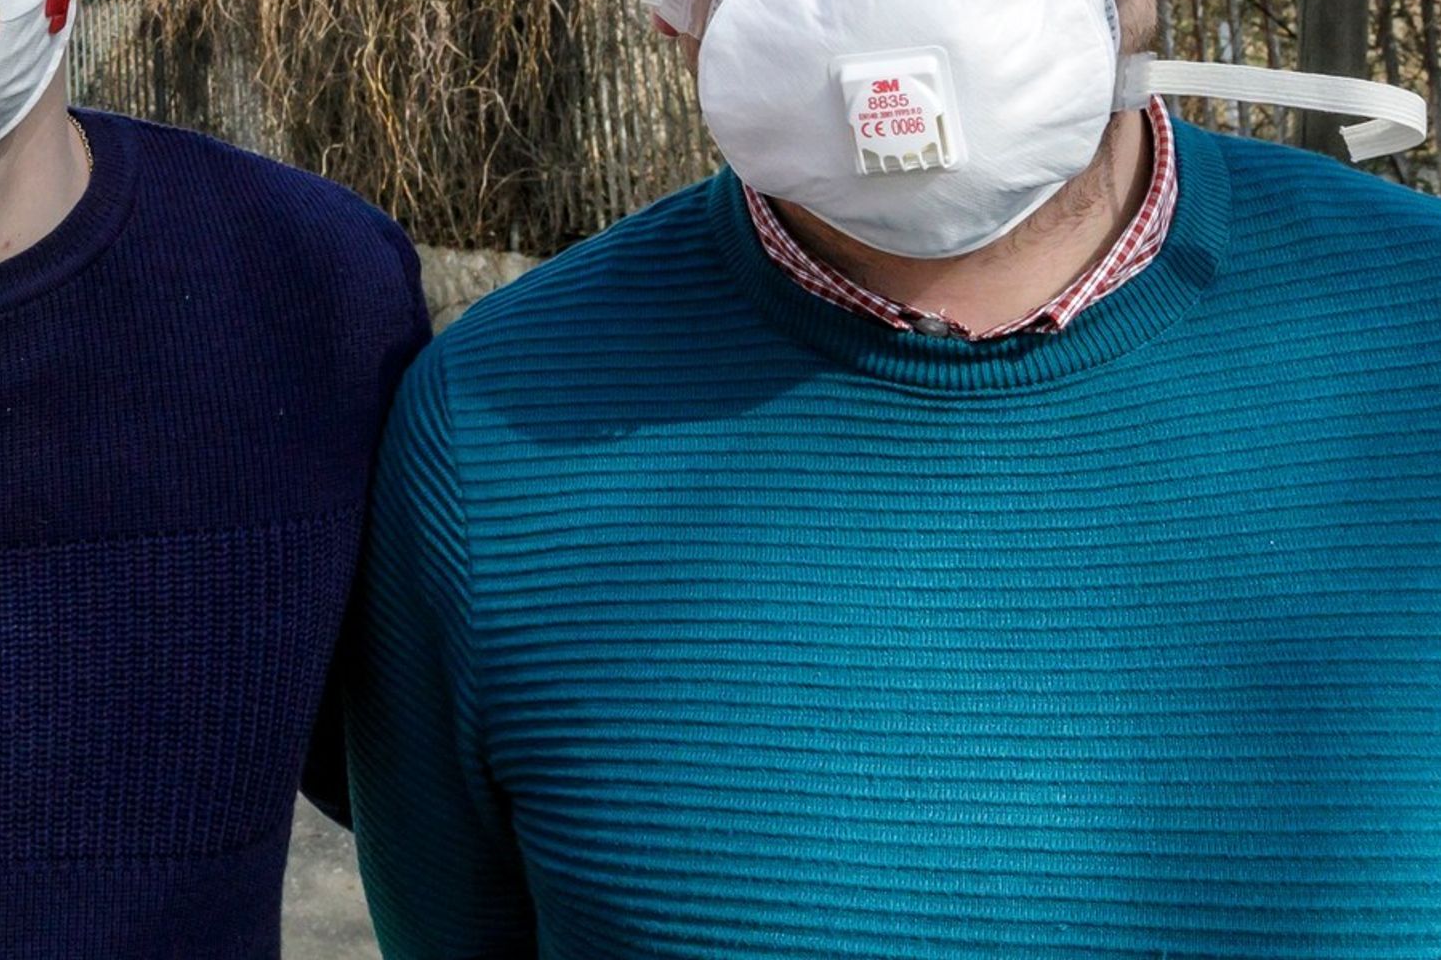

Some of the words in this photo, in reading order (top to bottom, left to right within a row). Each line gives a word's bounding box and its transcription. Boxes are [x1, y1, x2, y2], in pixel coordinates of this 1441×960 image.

[872, 79, 900, 94] 3M
[868, 93, 909, 110] 8835
[891, 117, 925, 135] 0086
